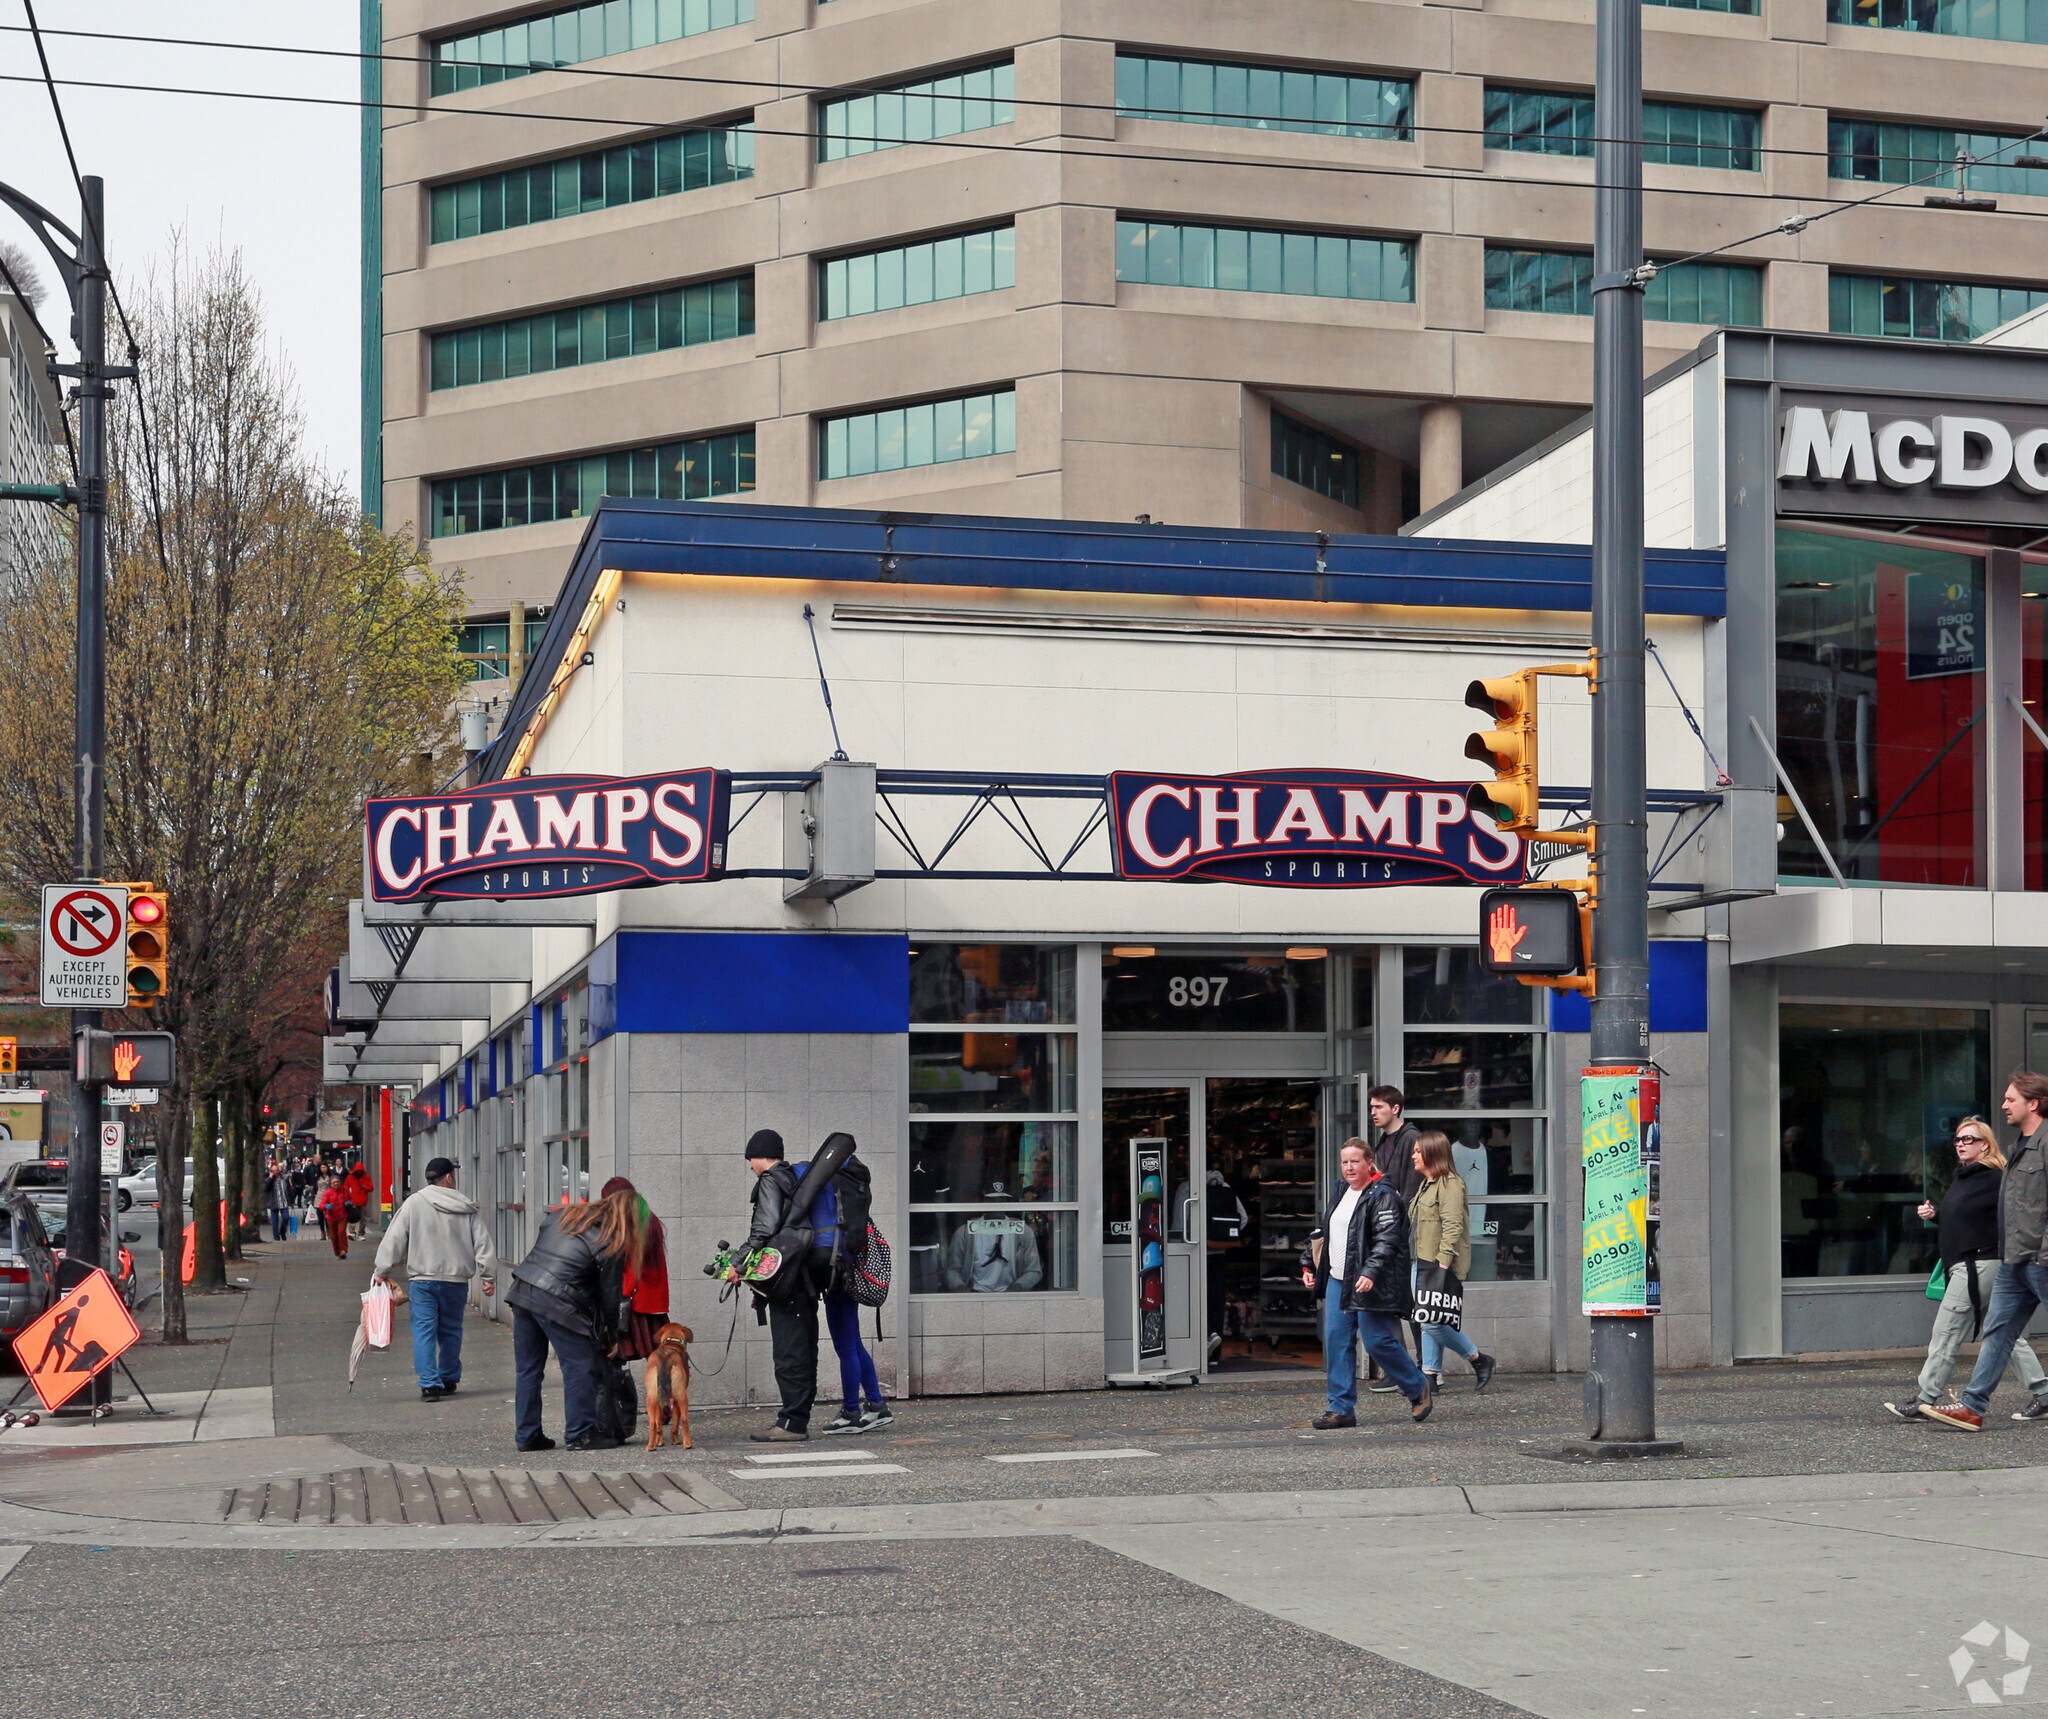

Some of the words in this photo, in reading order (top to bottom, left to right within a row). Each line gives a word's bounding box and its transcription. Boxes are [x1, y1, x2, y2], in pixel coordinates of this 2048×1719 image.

[376, 782, 703, 890] CHAMPS
[1126, 784, 1520, 869] CHAMPS
[1265, 860, 1391, 878] SPORTS
[62, 961, 105, 972] EXCEPT
[49, 974, 120, 985] AUTHORIZED
[56, 987, 111, 998] VEHICLES
[1168, 976, 1229, 1008] 897
[1590, 1111, 1608, 1123] APRIL
[1610, 1103, 1622, 1113] 3-6
[1587, 1141, 1630, 1168] 60-90
[1590, 1212, 1608, 1223] APRIL
[1610, 1206, 1622, 1214] 3-6
[1112, 1222, 1131, 1234] CH
[1587, 1243, 1629, 1269] 60-90
